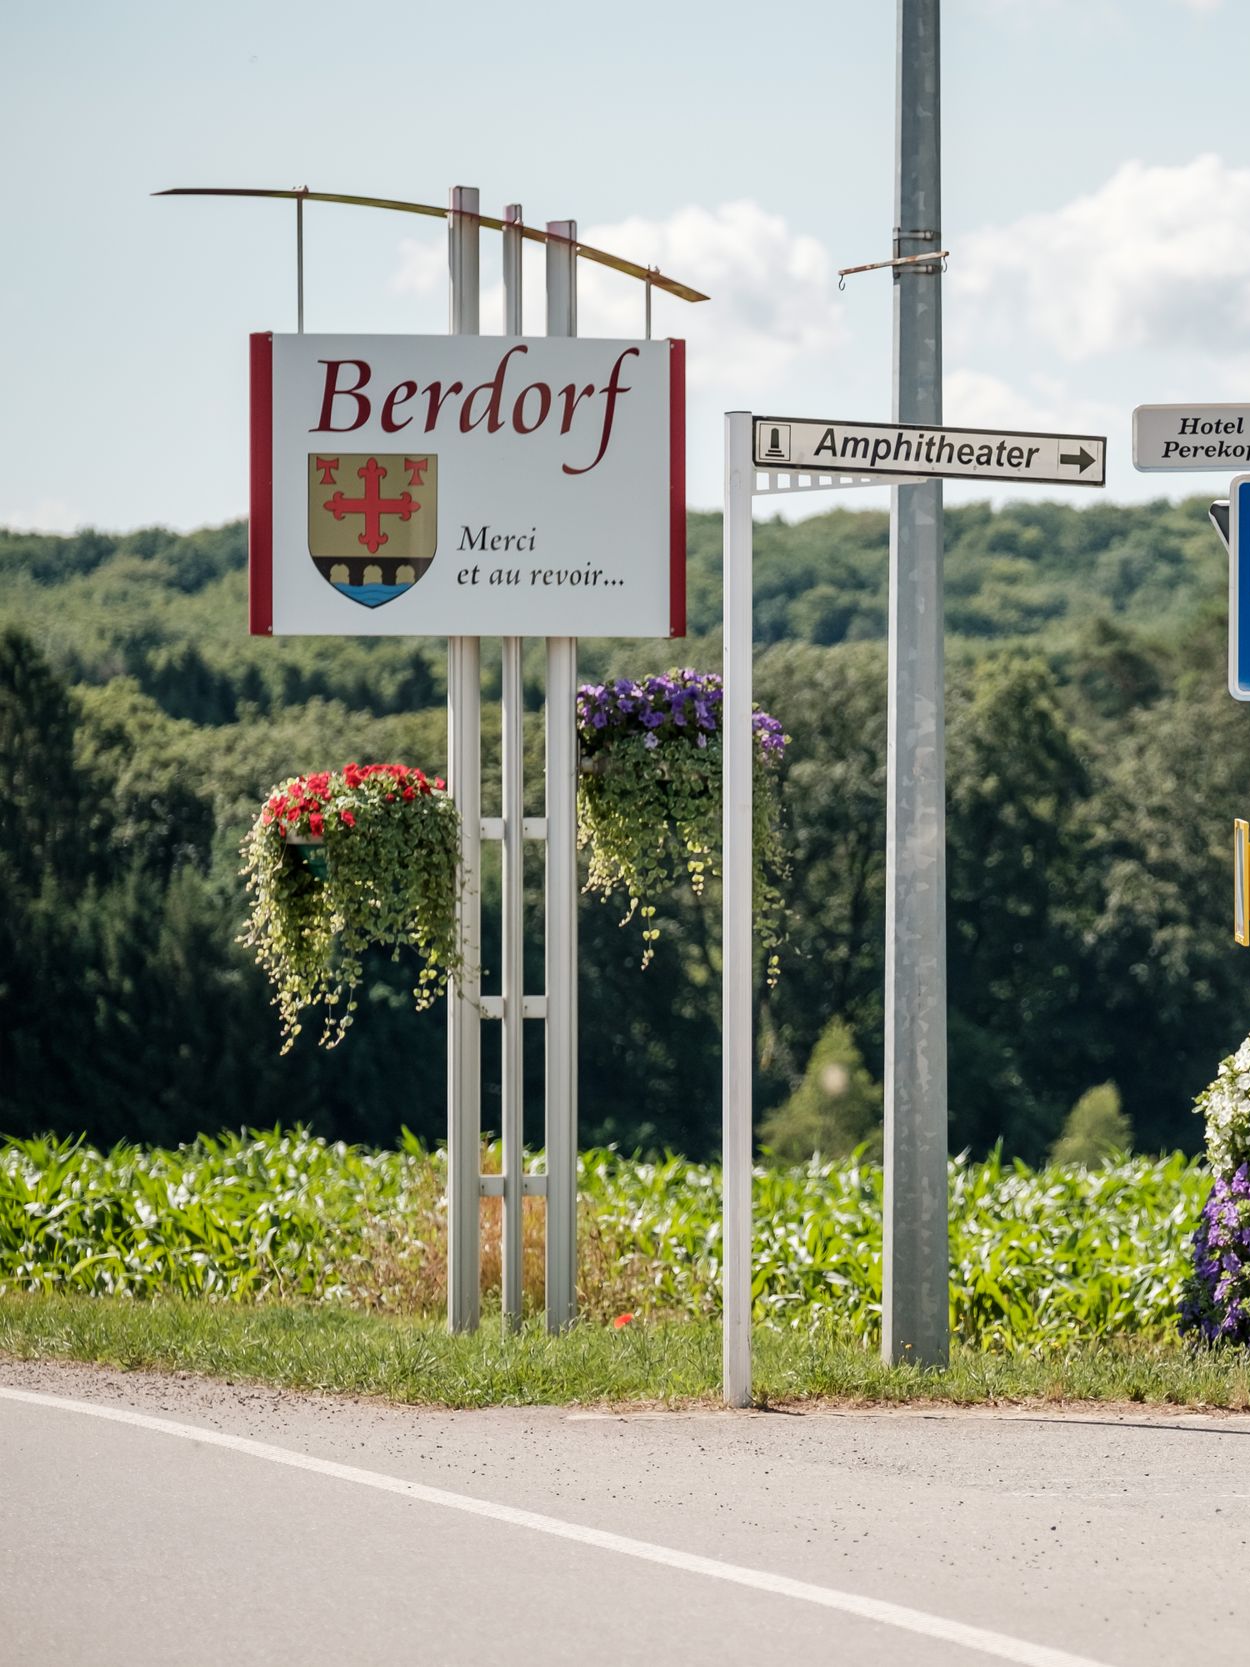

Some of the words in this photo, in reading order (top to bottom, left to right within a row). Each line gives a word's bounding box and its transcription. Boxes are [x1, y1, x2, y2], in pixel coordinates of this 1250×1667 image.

[308, 344, 640, 475] Berdorf
[1178, 417, 1244, 435] Hotel
[814, 427, 1040, 469] Amphitheater
[456, 525, 536, 551] Merci
[457, 563, 480, 586] et
[489, 568, 521, 586] au
[530, 561, 624, 586] revoir...
